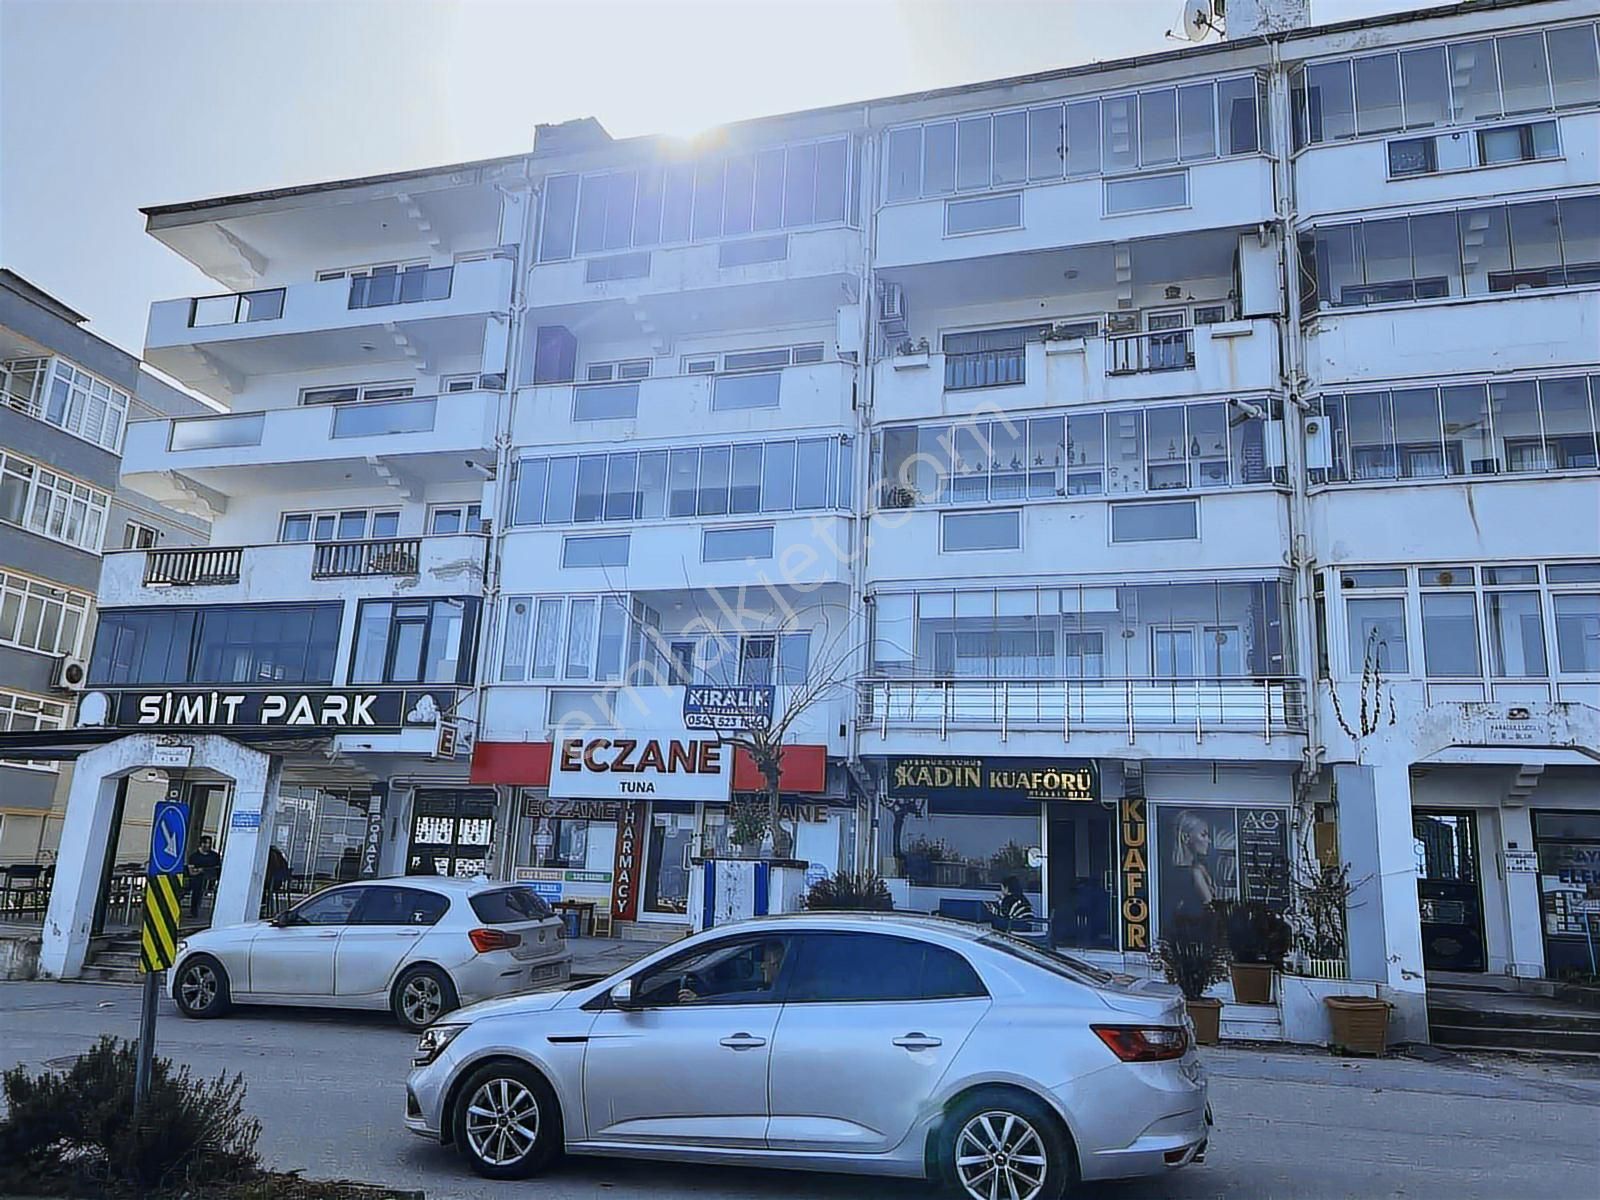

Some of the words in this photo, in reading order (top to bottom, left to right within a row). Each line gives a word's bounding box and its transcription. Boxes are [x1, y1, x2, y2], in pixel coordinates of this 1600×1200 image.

[138, 691, 245, 725] SİMİT
[261, 695, 377, 726] PARK
[560, 738, 722, 774] ECZANE
[619, 781, 656, 794] TUNA
[898, 765, 981, 788] KADIN
[989, 768, 1091, 791] KUAFÖRÜ
[525, 798, 620, 819] ECZANE
[1122, 799, 1148, 948] KUAFÖR
